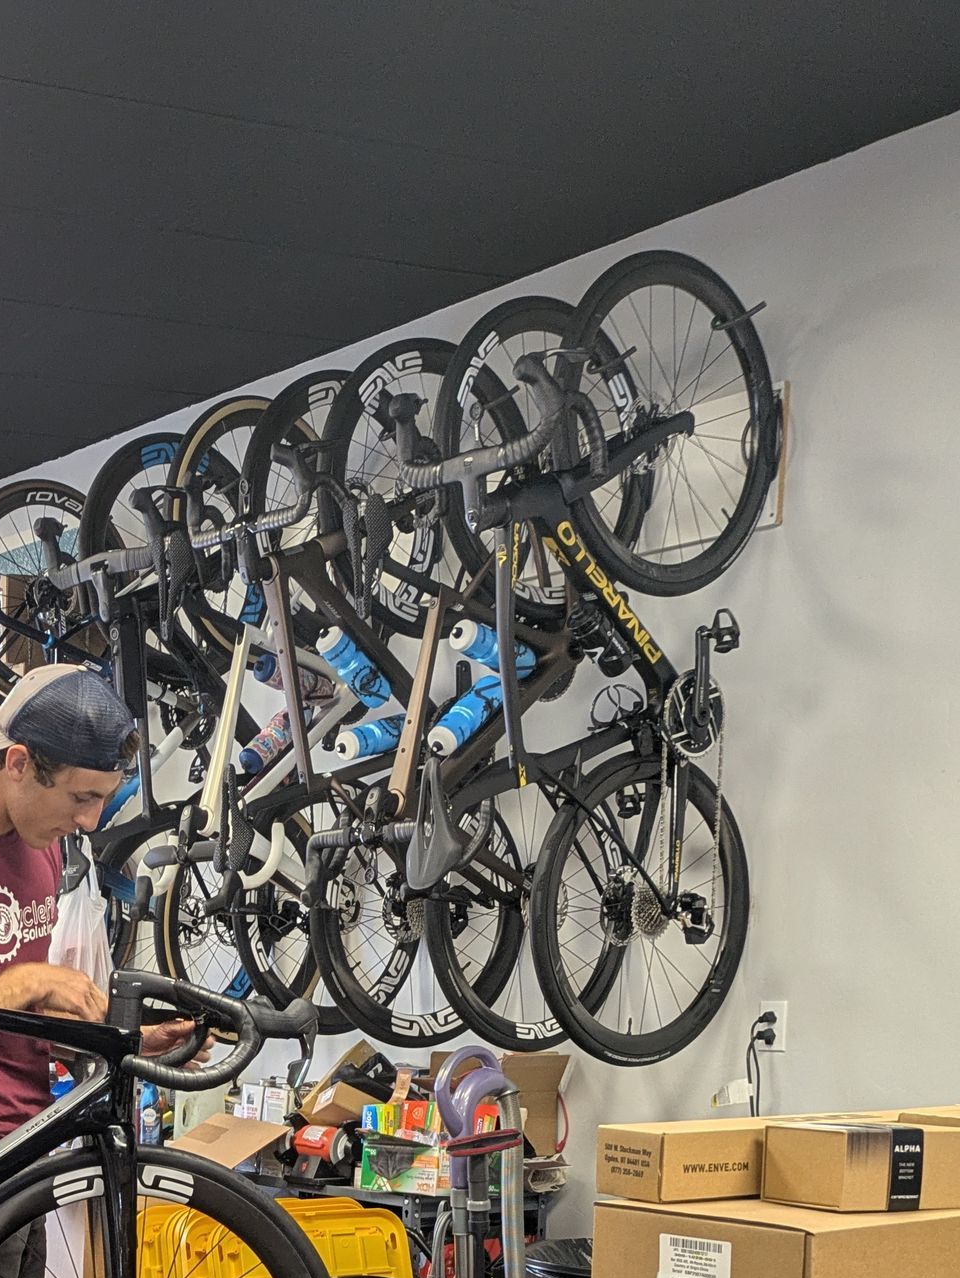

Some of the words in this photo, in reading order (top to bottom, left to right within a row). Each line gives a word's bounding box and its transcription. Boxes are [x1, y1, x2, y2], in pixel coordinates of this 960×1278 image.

[26, 491, 83, 514] rova
[894, 1144, 921, 1153] ALPHA
[682, 1161, 749, 1173] WWW.ENVE.COM
